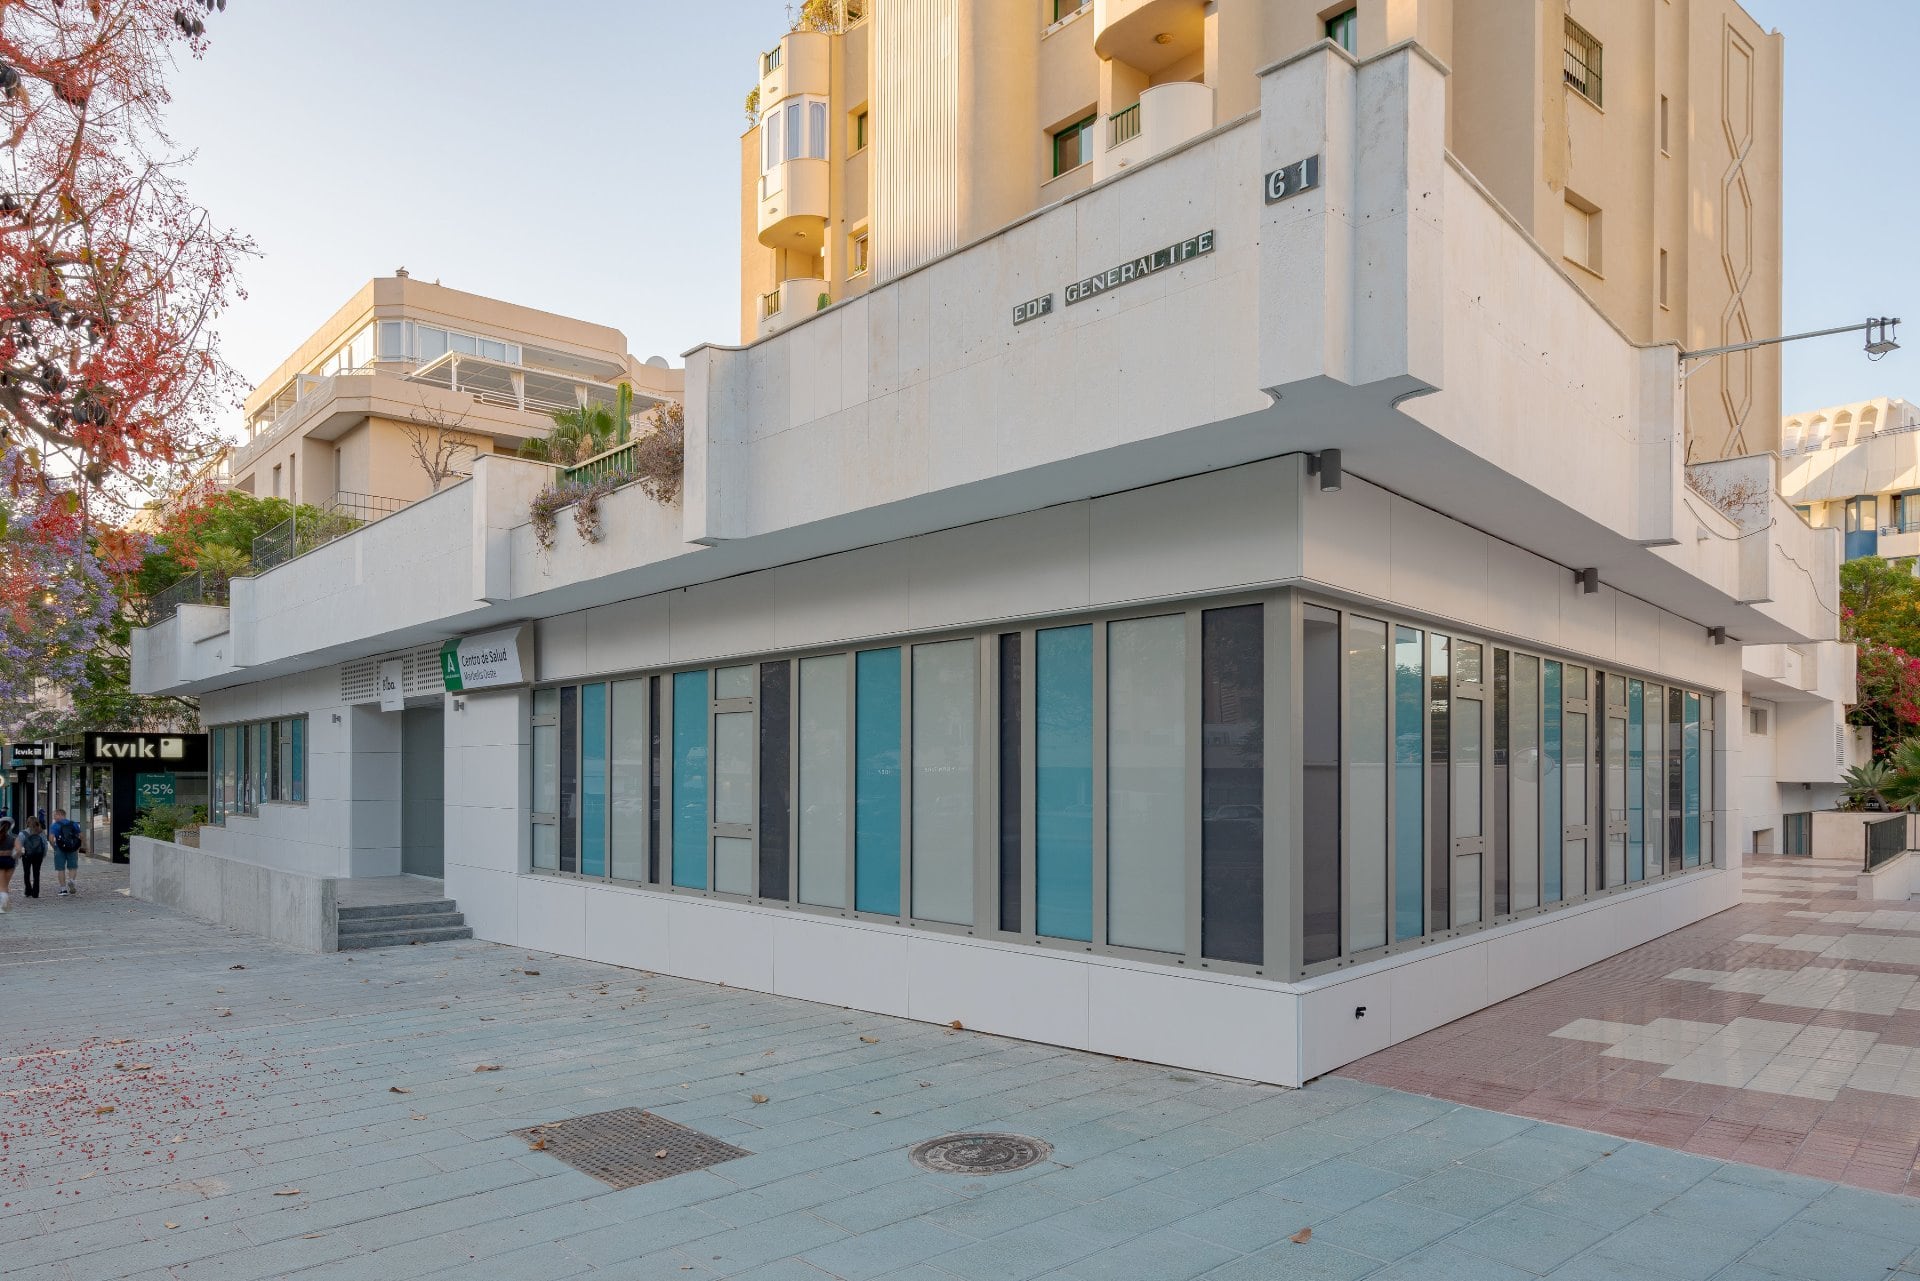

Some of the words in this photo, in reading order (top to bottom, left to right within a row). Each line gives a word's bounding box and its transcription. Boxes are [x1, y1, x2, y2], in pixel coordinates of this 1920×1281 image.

[1014, 295, 1050, 322] EDF
[1066, 232, 1213, 302] GENERALIFE
[461, 654, 481, 667] Centro
[481, 652, 489, 664] de
[489, 647, 508, 663] Salud
[15, 748, 34, 756] kvik
[96, 737, 155, 757] kvik
[138, 783, 174, 795] -25%
